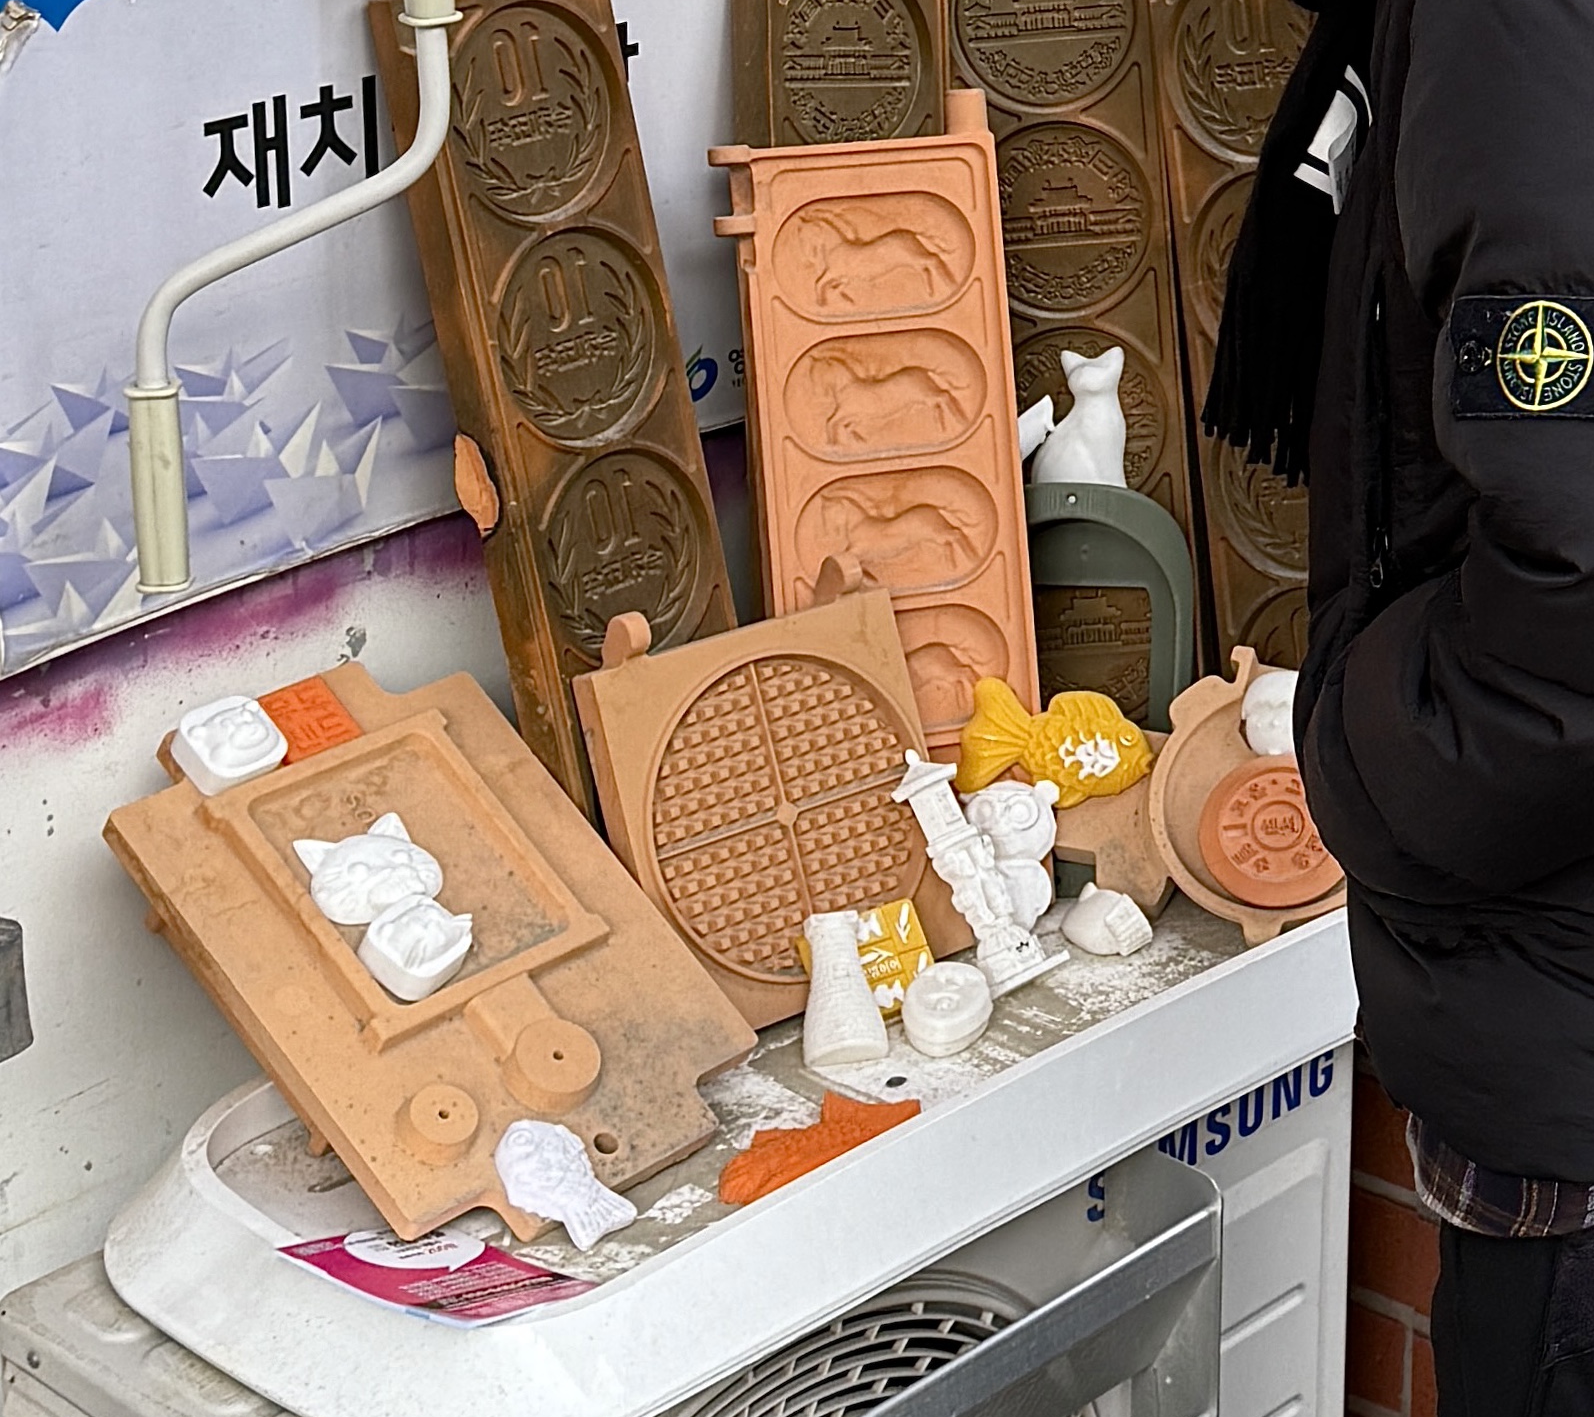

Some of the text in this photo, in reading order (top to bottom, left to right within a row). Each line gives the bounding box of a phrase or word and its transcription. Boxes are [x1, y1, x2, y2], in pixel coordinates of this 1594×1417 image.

[1504, 309, 1586, 353] STONE ISLAND
[1087, 1049, 1334, 1222] SMSUNG
